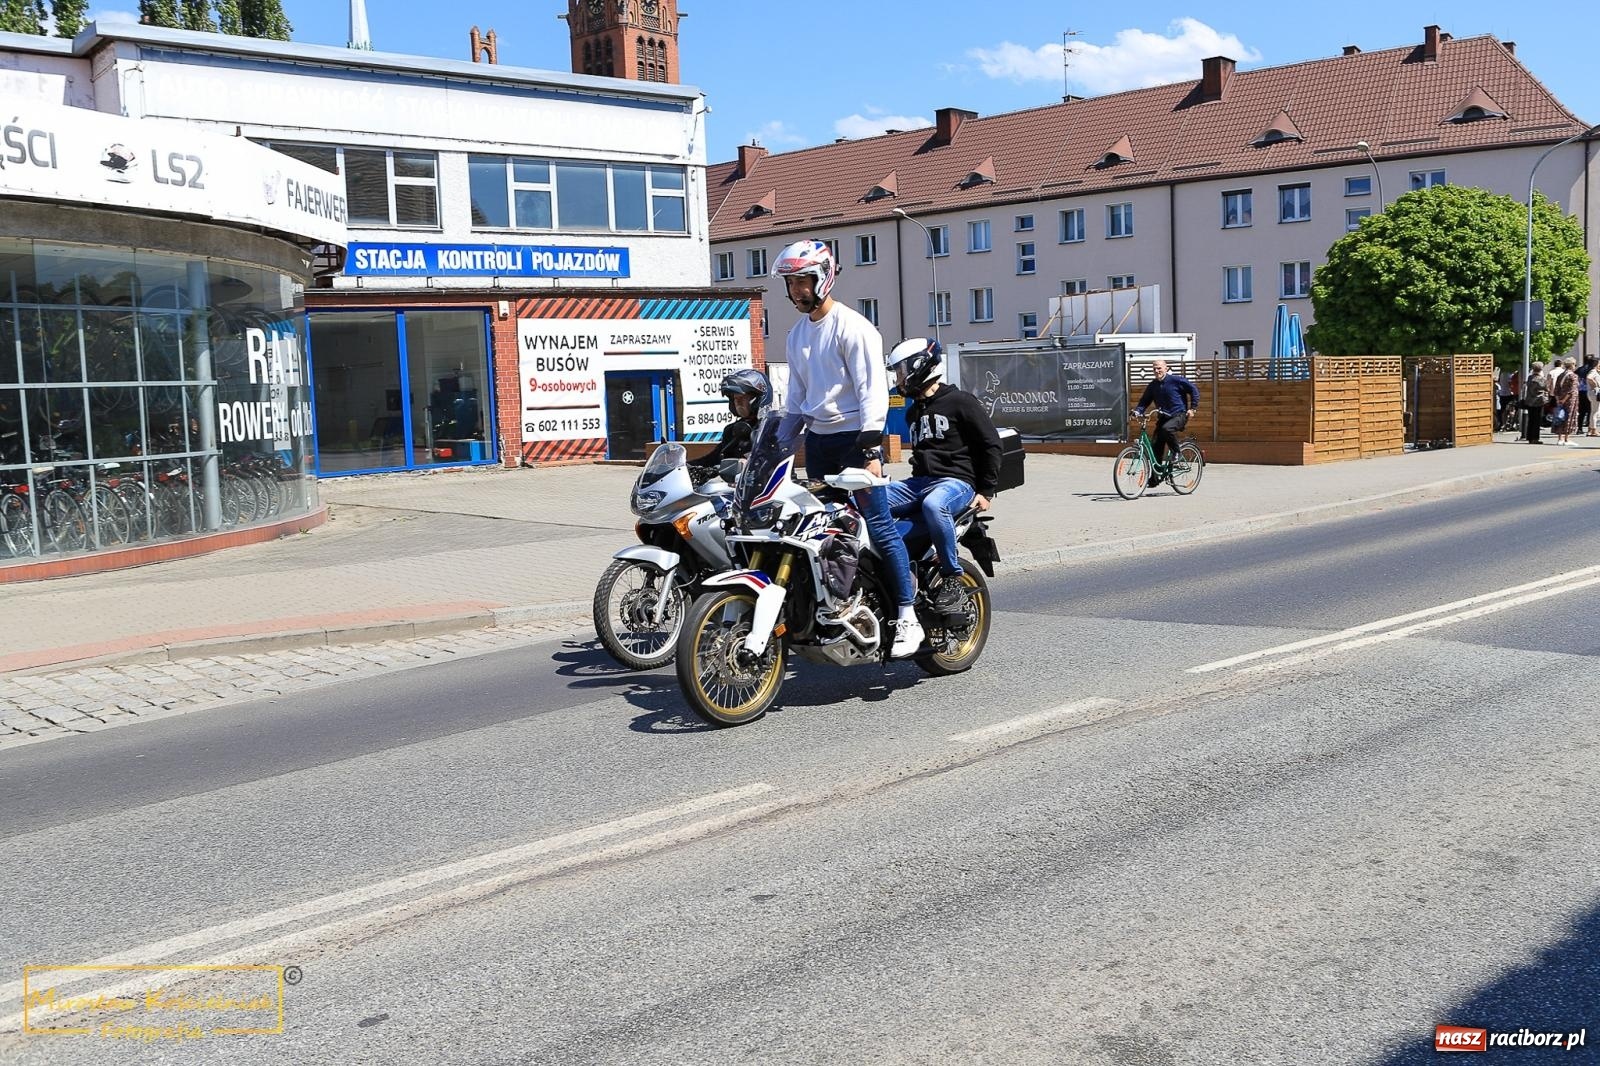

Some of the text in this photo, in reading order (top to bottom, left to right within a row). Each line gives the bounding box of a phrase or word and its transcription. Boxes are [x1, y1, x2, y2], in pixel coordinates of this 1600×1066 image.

[0, 116, 57, 170] ŚCI
[151, 148, 205, 190] LS2
[355, 248, 621, 272] STACJA KONTROLI POJAZDÓW
[700, 326, 735, 337] SERWIS
[525, 335, 599, 350] WYNAJEM
[610, 334, 672, 345] ZAPRASZAMY
[696, 340, 739, 351] SKUTERY
[536, 353, 589, 372] BUSÓW
[689, 354, 748, 366] MOTOROWERY
[1063, 361, 1114, 370] ZAPRASZAMY!
[529, 377, 597, 394] 9-osobowych
[703, 382, 722, 395] QUA
[219, 401, 288, 443] ROWERY
[538, 418, 600, 432] 602 111 553
[698, 411, 733, 425] 884 049
[1072, 418, 1085, 427] 537
